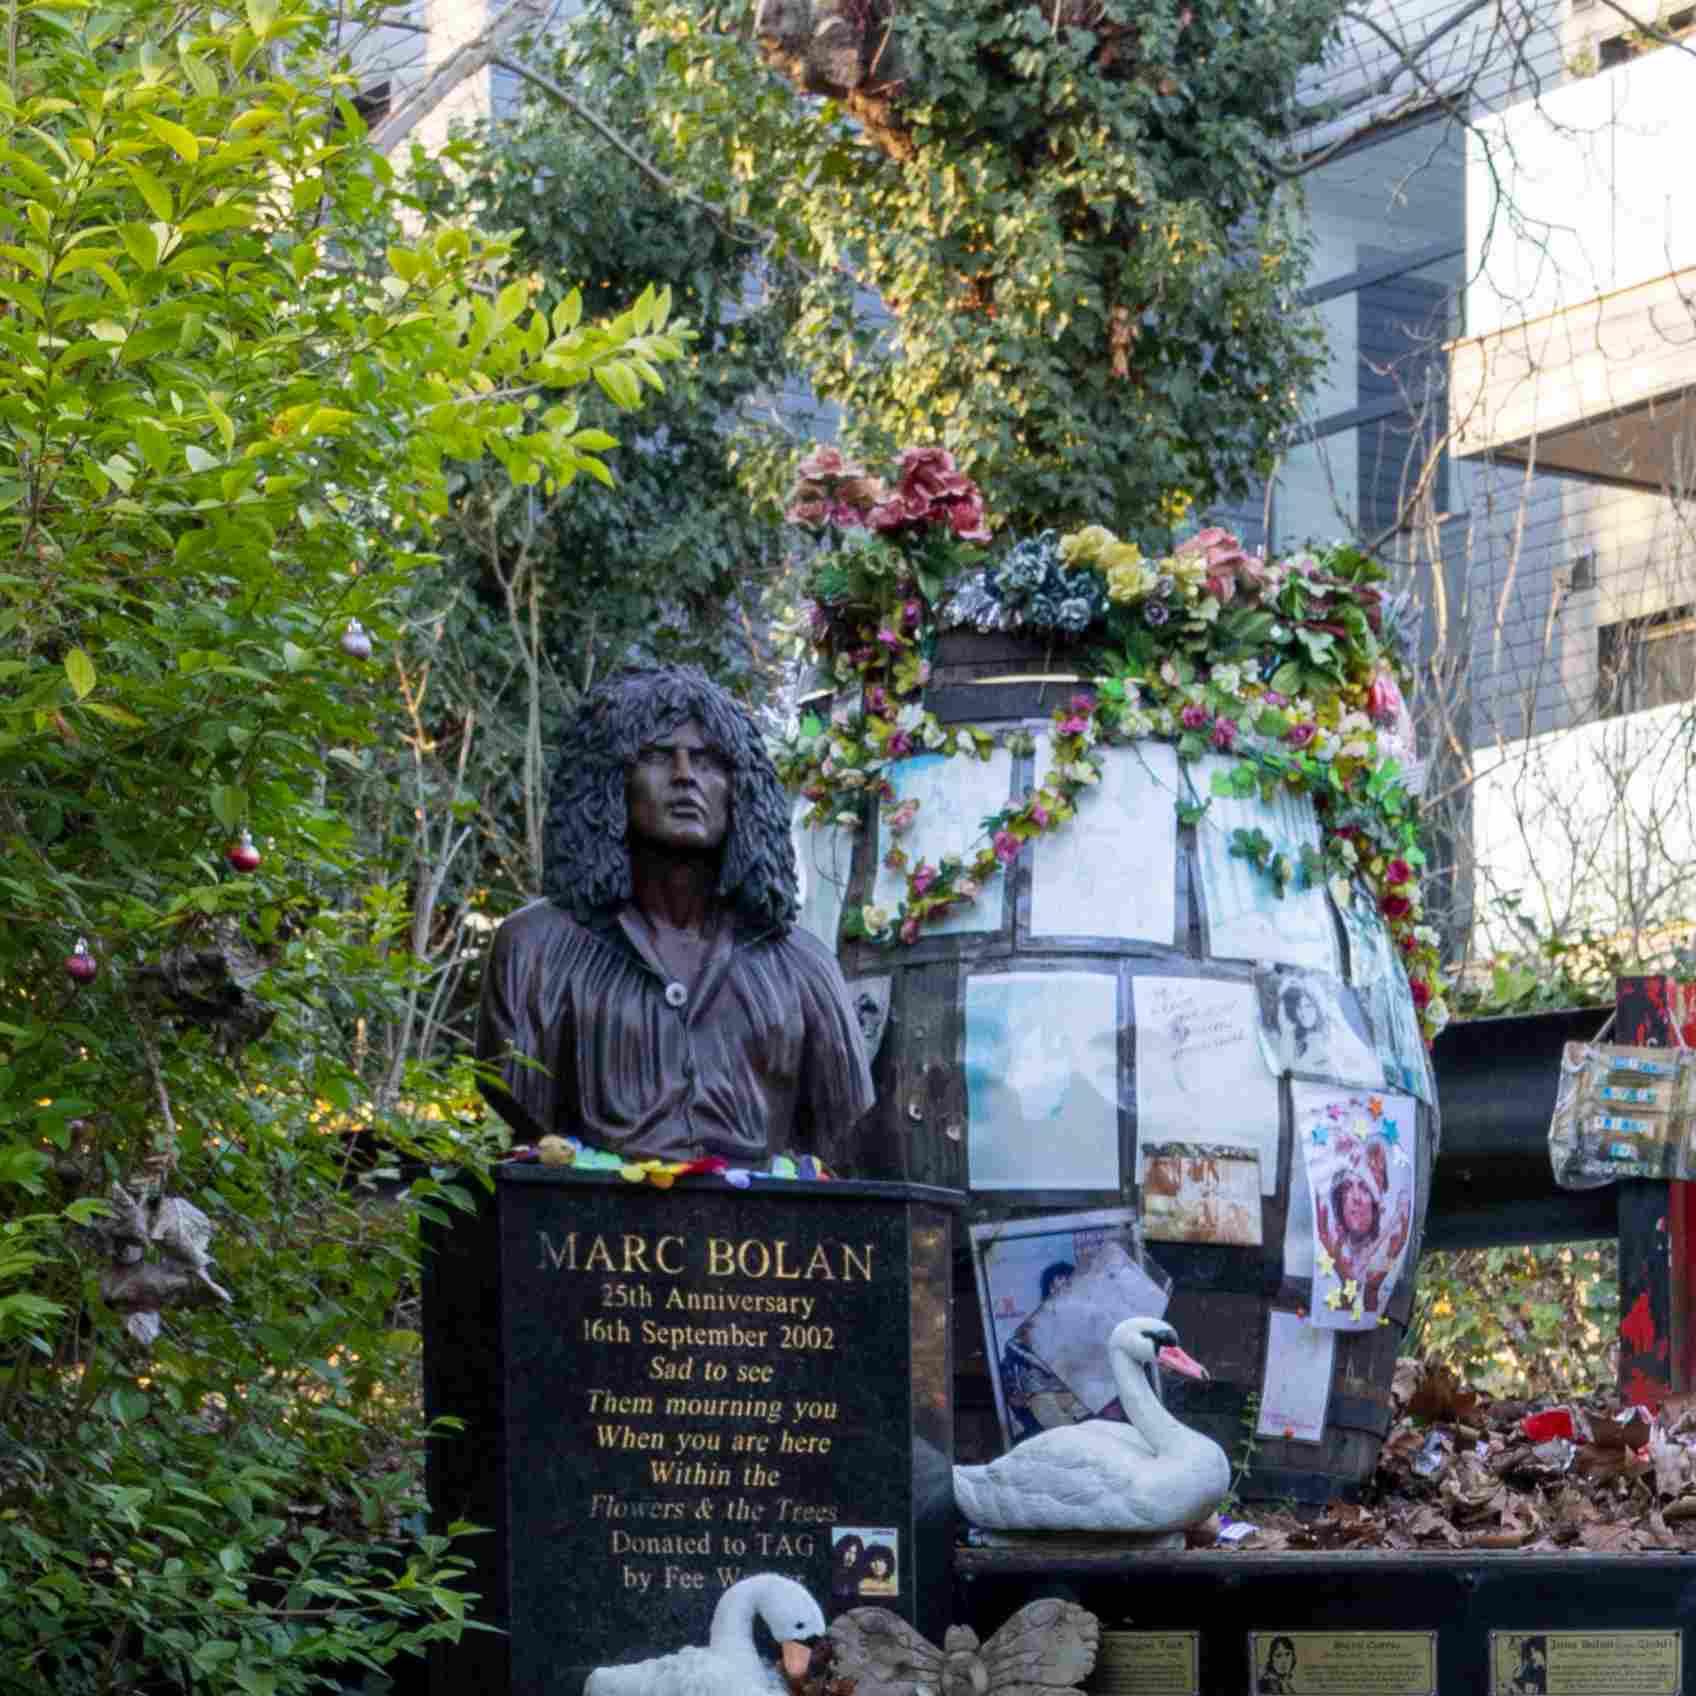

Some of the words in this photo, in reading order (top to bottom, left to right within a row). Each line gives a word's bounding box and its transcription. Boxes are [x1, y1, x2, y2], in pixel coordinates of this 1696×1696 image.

[537, 1231, 686, 1273] MARC
[707, 1237, 873, 1281] BOLAN
[602, 1283, 653, 1307] 25th
[665, 1288, 815, 1320] Anniversary
[584, 1319, 631, 1343] 16th
[642, 1320, 768, 1349] September
[780, 1325, 834, 1350] 2002
[649, 1356, 693, 1381] Sad
[704, 1360, 727, 1380] to
[736, 1366, 773, 1382] see
[586, 1390, 653, 1414] Them
[664, 1394, 782, 1424] mourning
[793, 1402, 839, 1423] you
[596, 1425, 663, 1450] When
[676, 1432, 720, 1455] you
[731, 1434, 769, 1452] are
[780, 1429, 832, 1453] here
[651, 1460, 731, 1487] Within
[743, 1463, 780, 1487] the
[589, 1493, 684, 1519] Flowers
[695, 1498, 713, 1519] &
[727, 1497, 765, 1521] the
[776, 1498, 838, 1523] Trees
[611, 1529, 710, 1555] Donated
[723, 1535, 746, 1556] to
[755, 1532, 814, 1557] TAG
[623, 1566, 651, 1592] by
[664, 1567, 704, 1589] Fee
